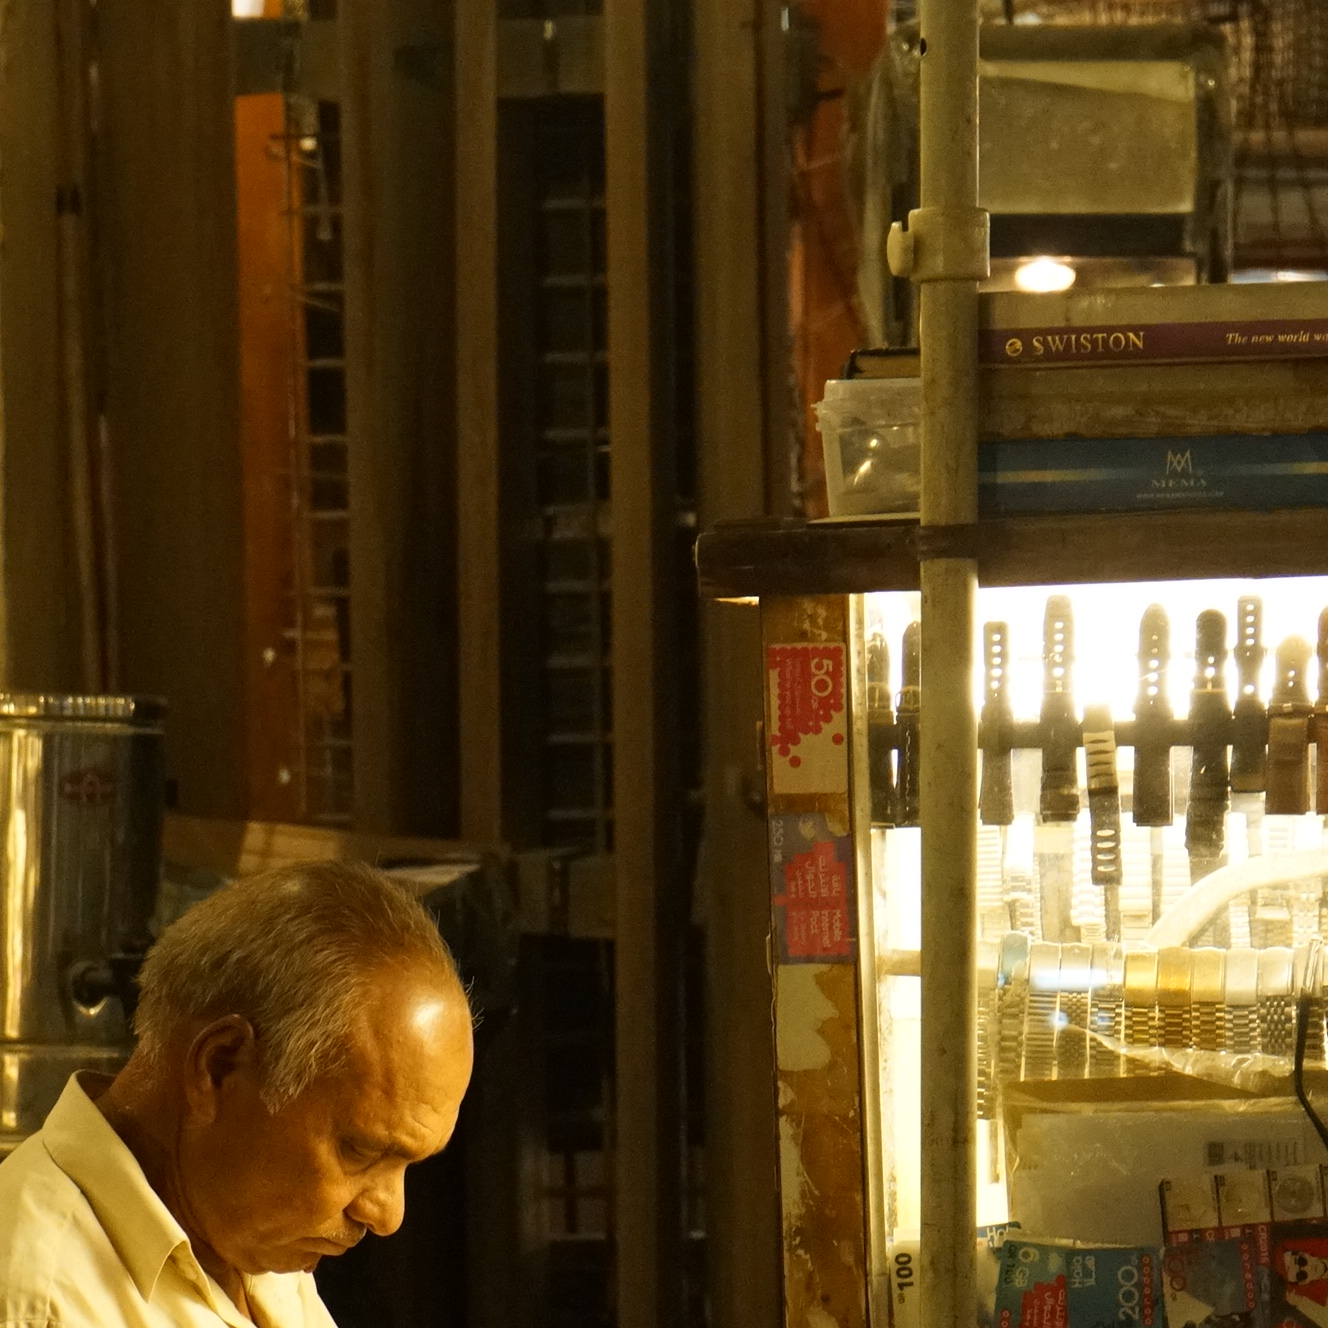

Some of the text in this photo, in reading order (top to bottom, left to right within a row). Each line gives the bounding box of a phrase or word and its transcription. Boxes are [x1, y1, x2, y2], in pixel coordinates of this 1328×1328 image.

[1033, 331, 1145, 356] SWISTON
[1226, 332, 1248, 345] The
[1251, 333, 1274, 344] new
[1277, 331, 1309, 344] world
[810, 658, 833, 697] 50
[772, 820, 784, 863] 250 MB
[810, 910, 819, 934] Pack
[821, 910, 831, 948] Internet
[833, 909, 842, 942] Mobile
[1018, 1247, 1039, 1262] 6
[1071, 1256, 1083, 1288] Hala
[895, 1253, 914, 1304] QR 100
[1117, 1266, 1140, 1320] 200
[1240, 1243, 1256, 1310] ooredoo
